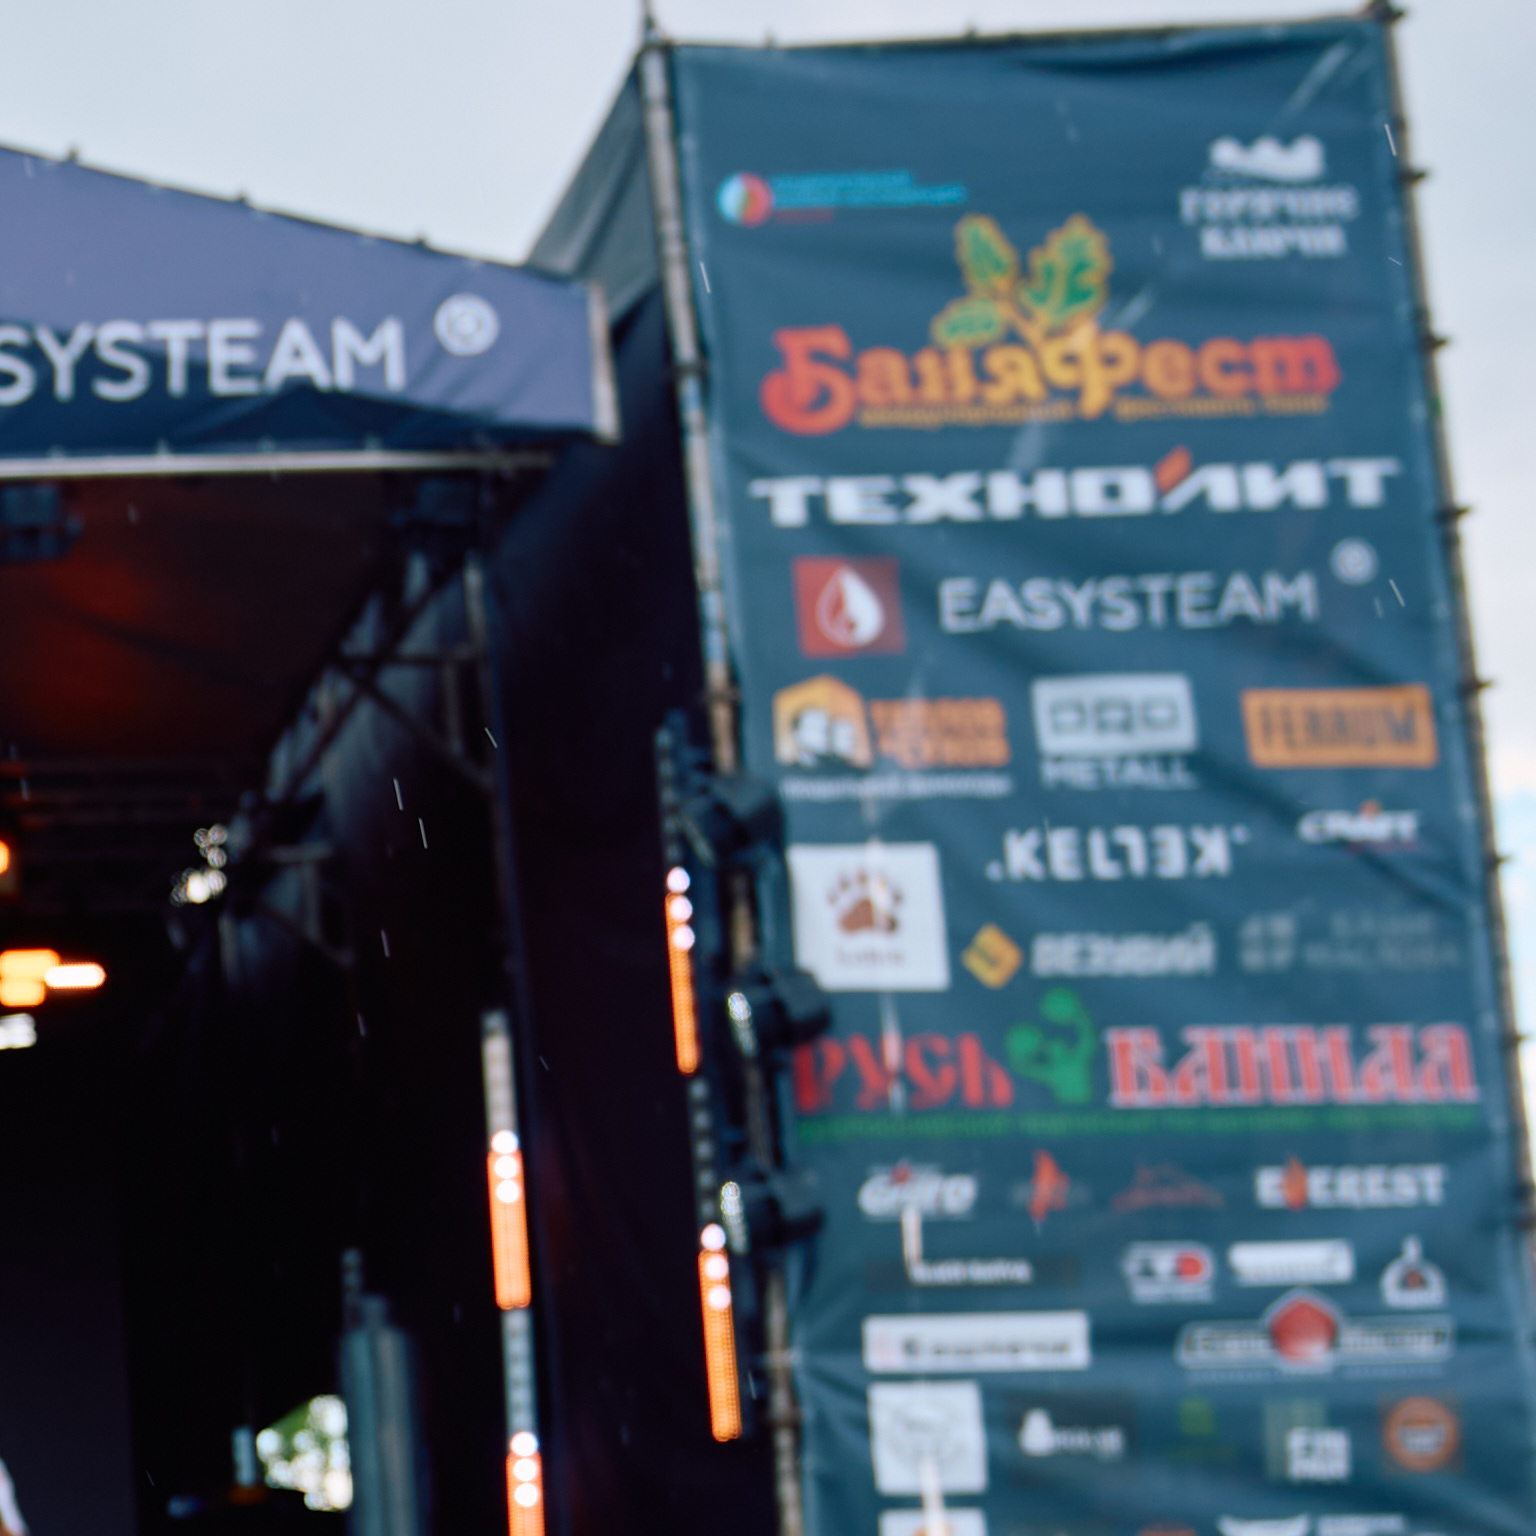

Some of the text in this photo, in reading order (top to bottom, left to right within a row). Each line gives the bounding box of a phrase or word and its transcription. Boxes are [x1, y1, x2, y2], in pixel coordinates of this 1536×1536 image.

[749, 456, 1403, 528] ТЕХНОЛИТ
[937, 571, 1318, 633] EASYSTEAM
[1261, 702, 1418, 752] FERRUM
[1042, 757, 1198, 790] METALL
